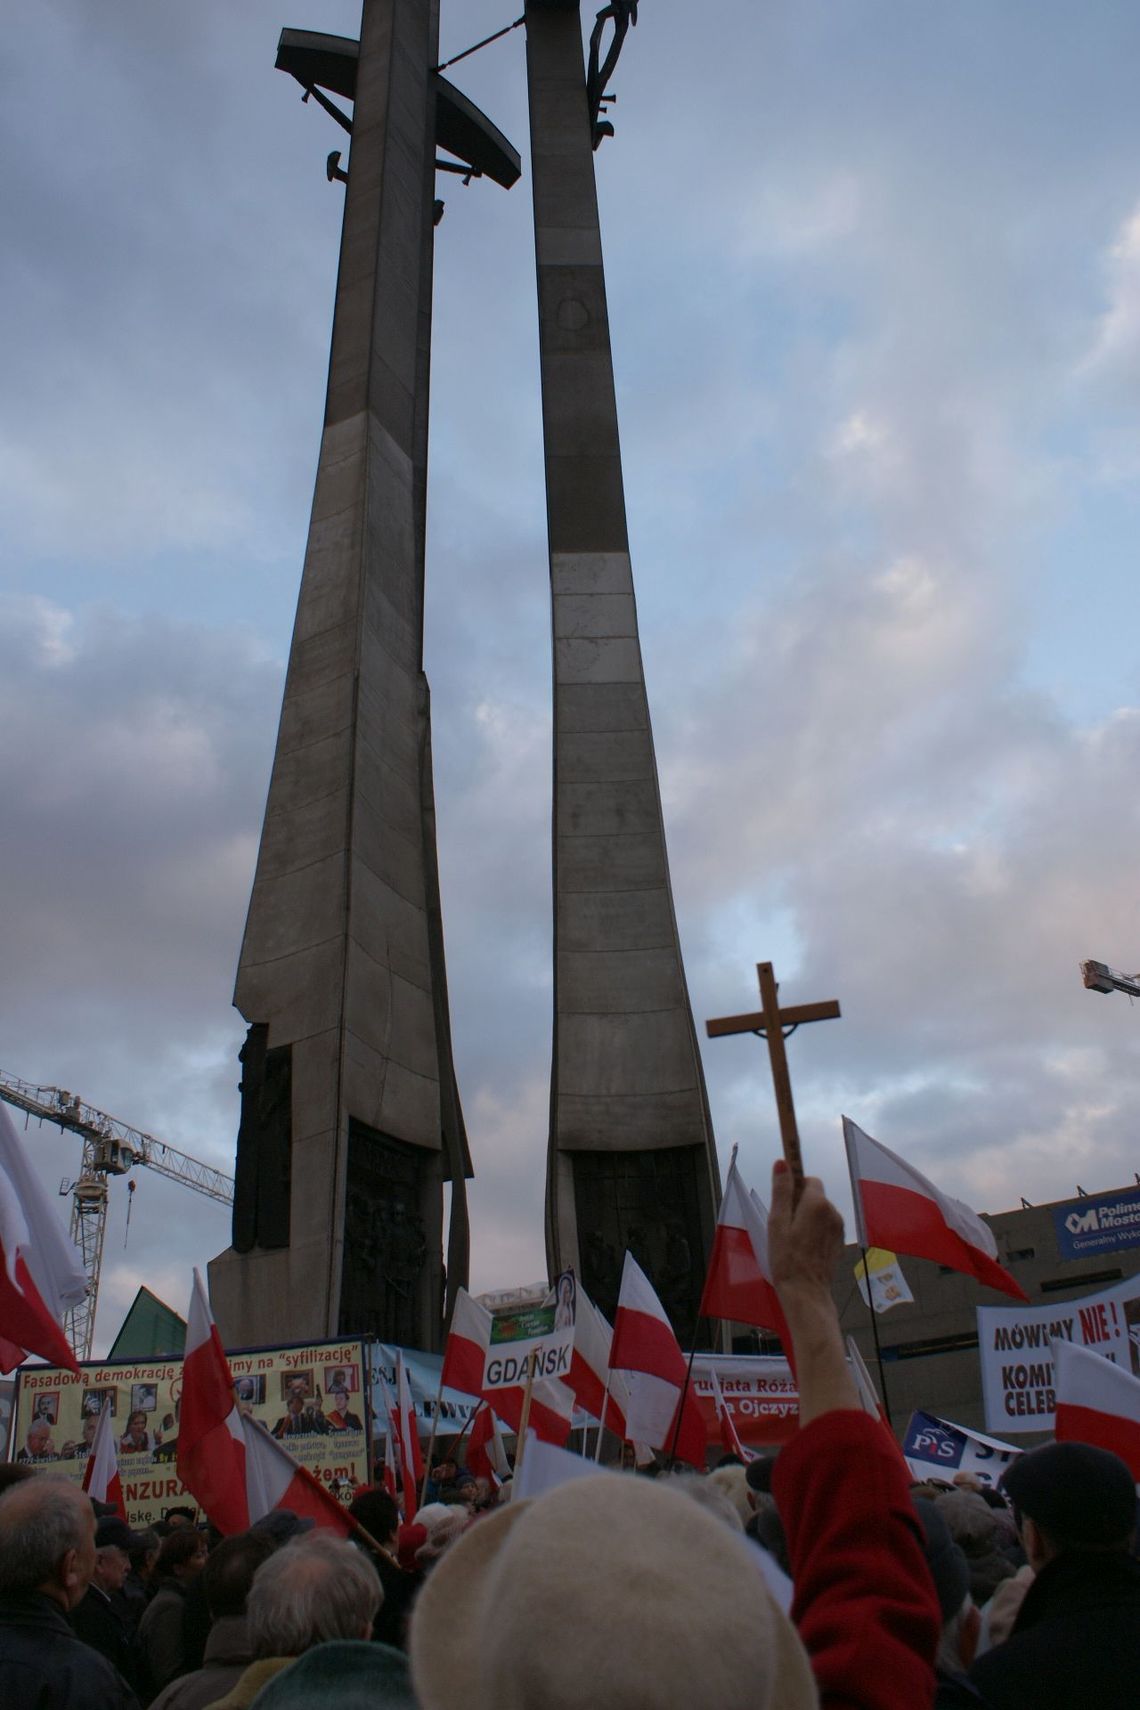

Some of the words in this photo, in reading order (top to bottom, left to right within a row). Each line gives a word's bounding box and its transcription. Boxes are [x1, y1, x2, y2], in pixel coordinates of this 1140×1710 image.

[24, 1371, 90, 1388] Fasadową
[95, 1365, 174, 1383] demokrację
[257, 1358, 273, 1369] na
[487, 1344, 570, 1384] GDAŃSK
[739, 1399, 799, 1418] Ojczyz
[1004, 1390, 1057, 1417] CELEB
[911, 1433, 955, 1457] PiS
